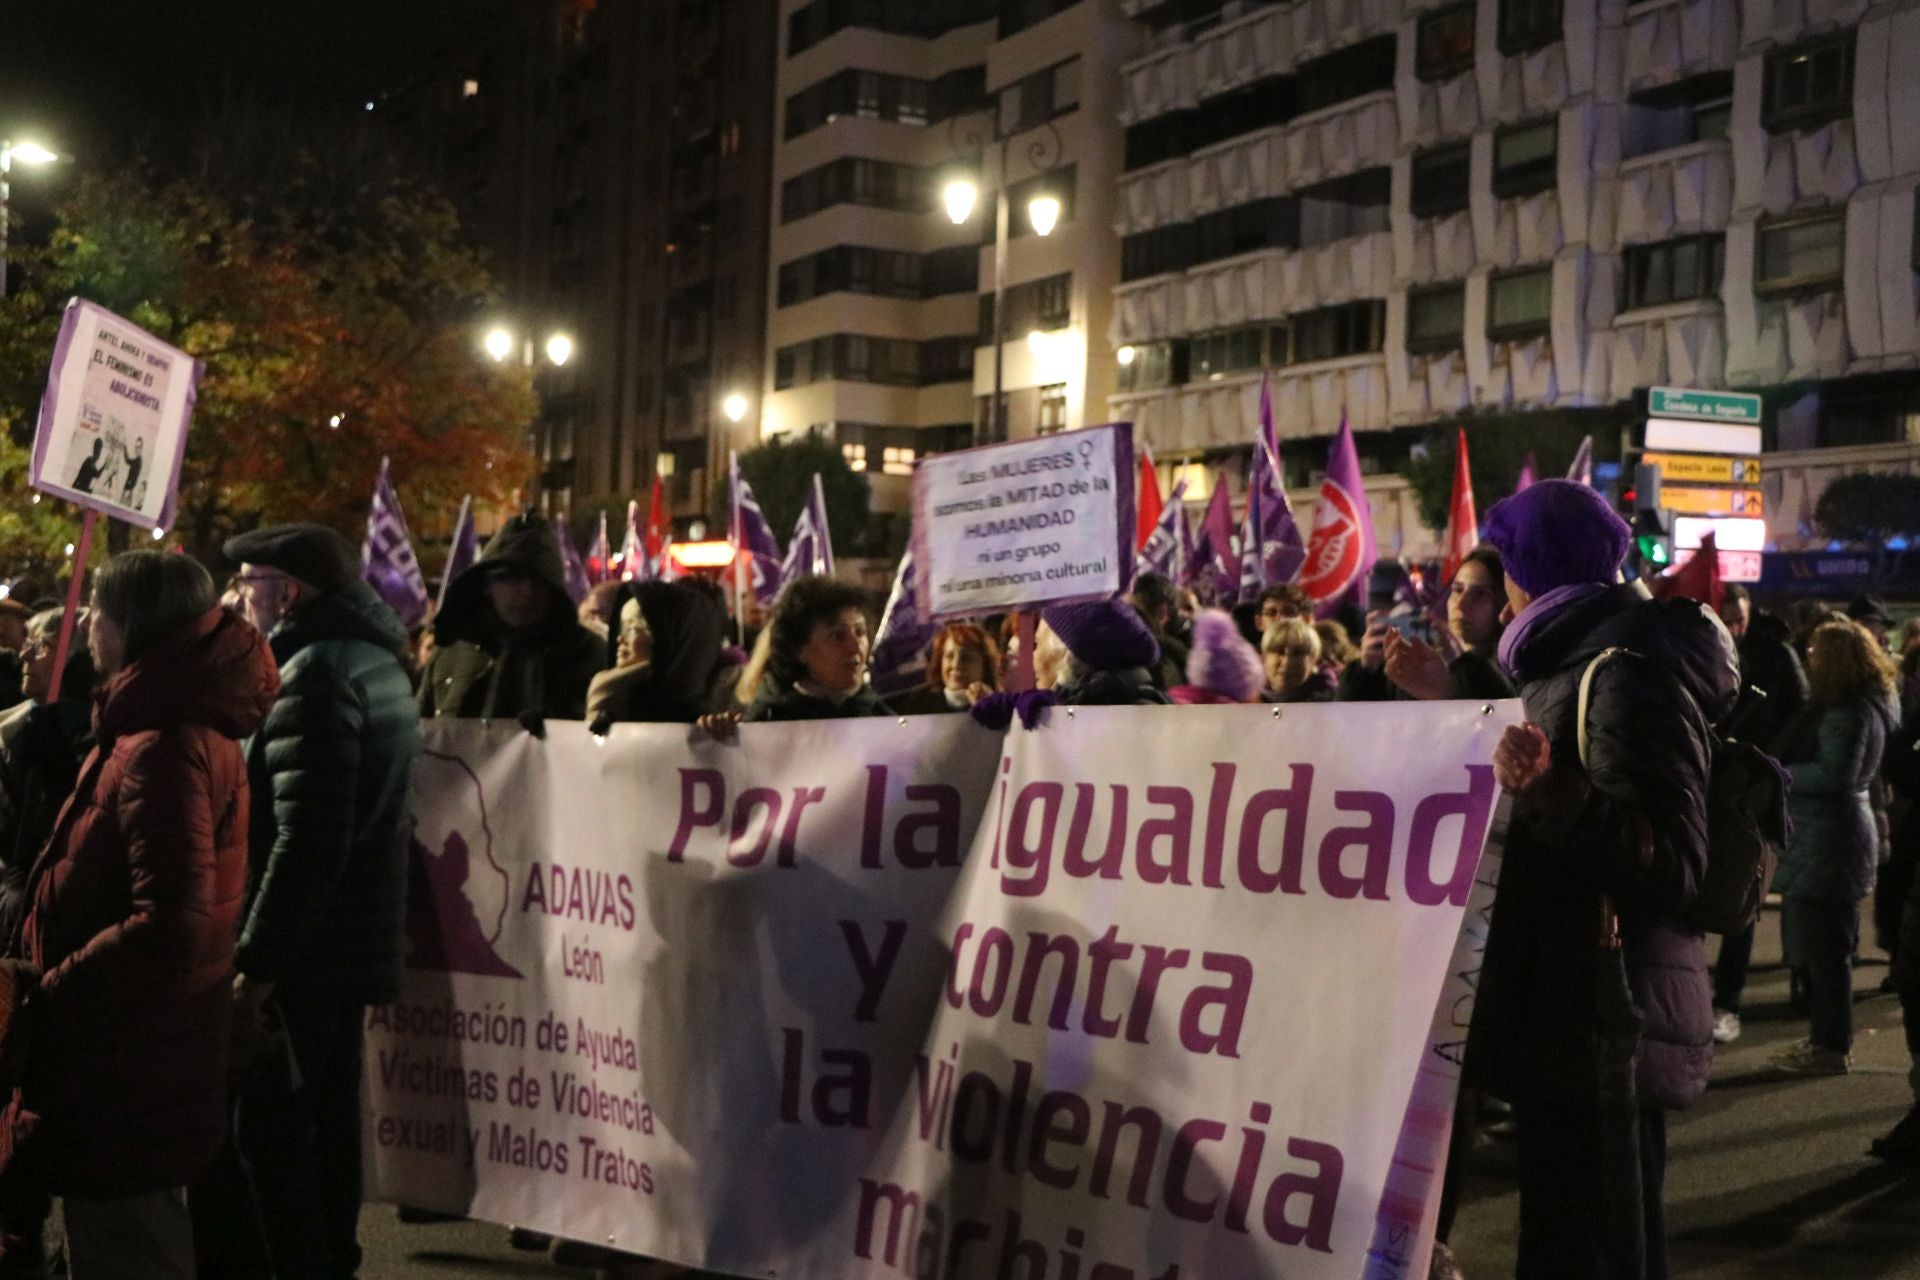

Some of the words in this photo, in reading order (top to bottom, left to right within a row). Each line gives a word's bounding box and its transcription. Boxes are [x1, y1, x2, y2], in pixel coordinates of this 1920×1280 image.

[93, 348, 104, 365] EL
[105, 354, 143, 382] FEMINISMO
[143, 372, 154, 388] ES
[934, 500, 985, 518] somos
[989, 493, 1004, 508] la
[1006, 482, 1065, 505] MITAD
[1068, 479, 1089, 497] de
[1093, 475, 1111, 493] la
[958, 470, 987, 486] Las
[990, 452, 1075, 479] MUJERES
[964, 508, 1076, 540] HUMANIDAD
[977, 551, 990, 564] ni
[993, 549, 1013, 563] un
[1015, 541, 1062, 563] grupo
[957, 577, 983, 592] una
[1046, 558, 1107, 580] cultural
[667, 766, 826, 871] Por
[859, 762, 962, 870] la
[990, 756, 1495, 908] igualdad
[522, 861, 636, 931] ADAVAS
[561, 934, 604, 986] León
[838, 919, 908, 1022] y
[946, 921, 1255, 1059] contra
[368, 1001, 527, 1048] Asociación
[536, 1010, 569, 1054] de
[576, 1017, 638, 1072] Ayuda
[378, 1047, 499, 1103] Víctimas
[508, 1066, 541, 1110] de
[550, 1070, 655, 1136] Violencia
[377, 1115, 456, 1155] exual
[463, 1126, 481, 1168] y
[488, 1121, 569, 1175] Malos
[578, 1136, 655, 1196] Tratos
[779, 1027, 872, 1130] la
[915, 1043, 1345, 1254] violencia
